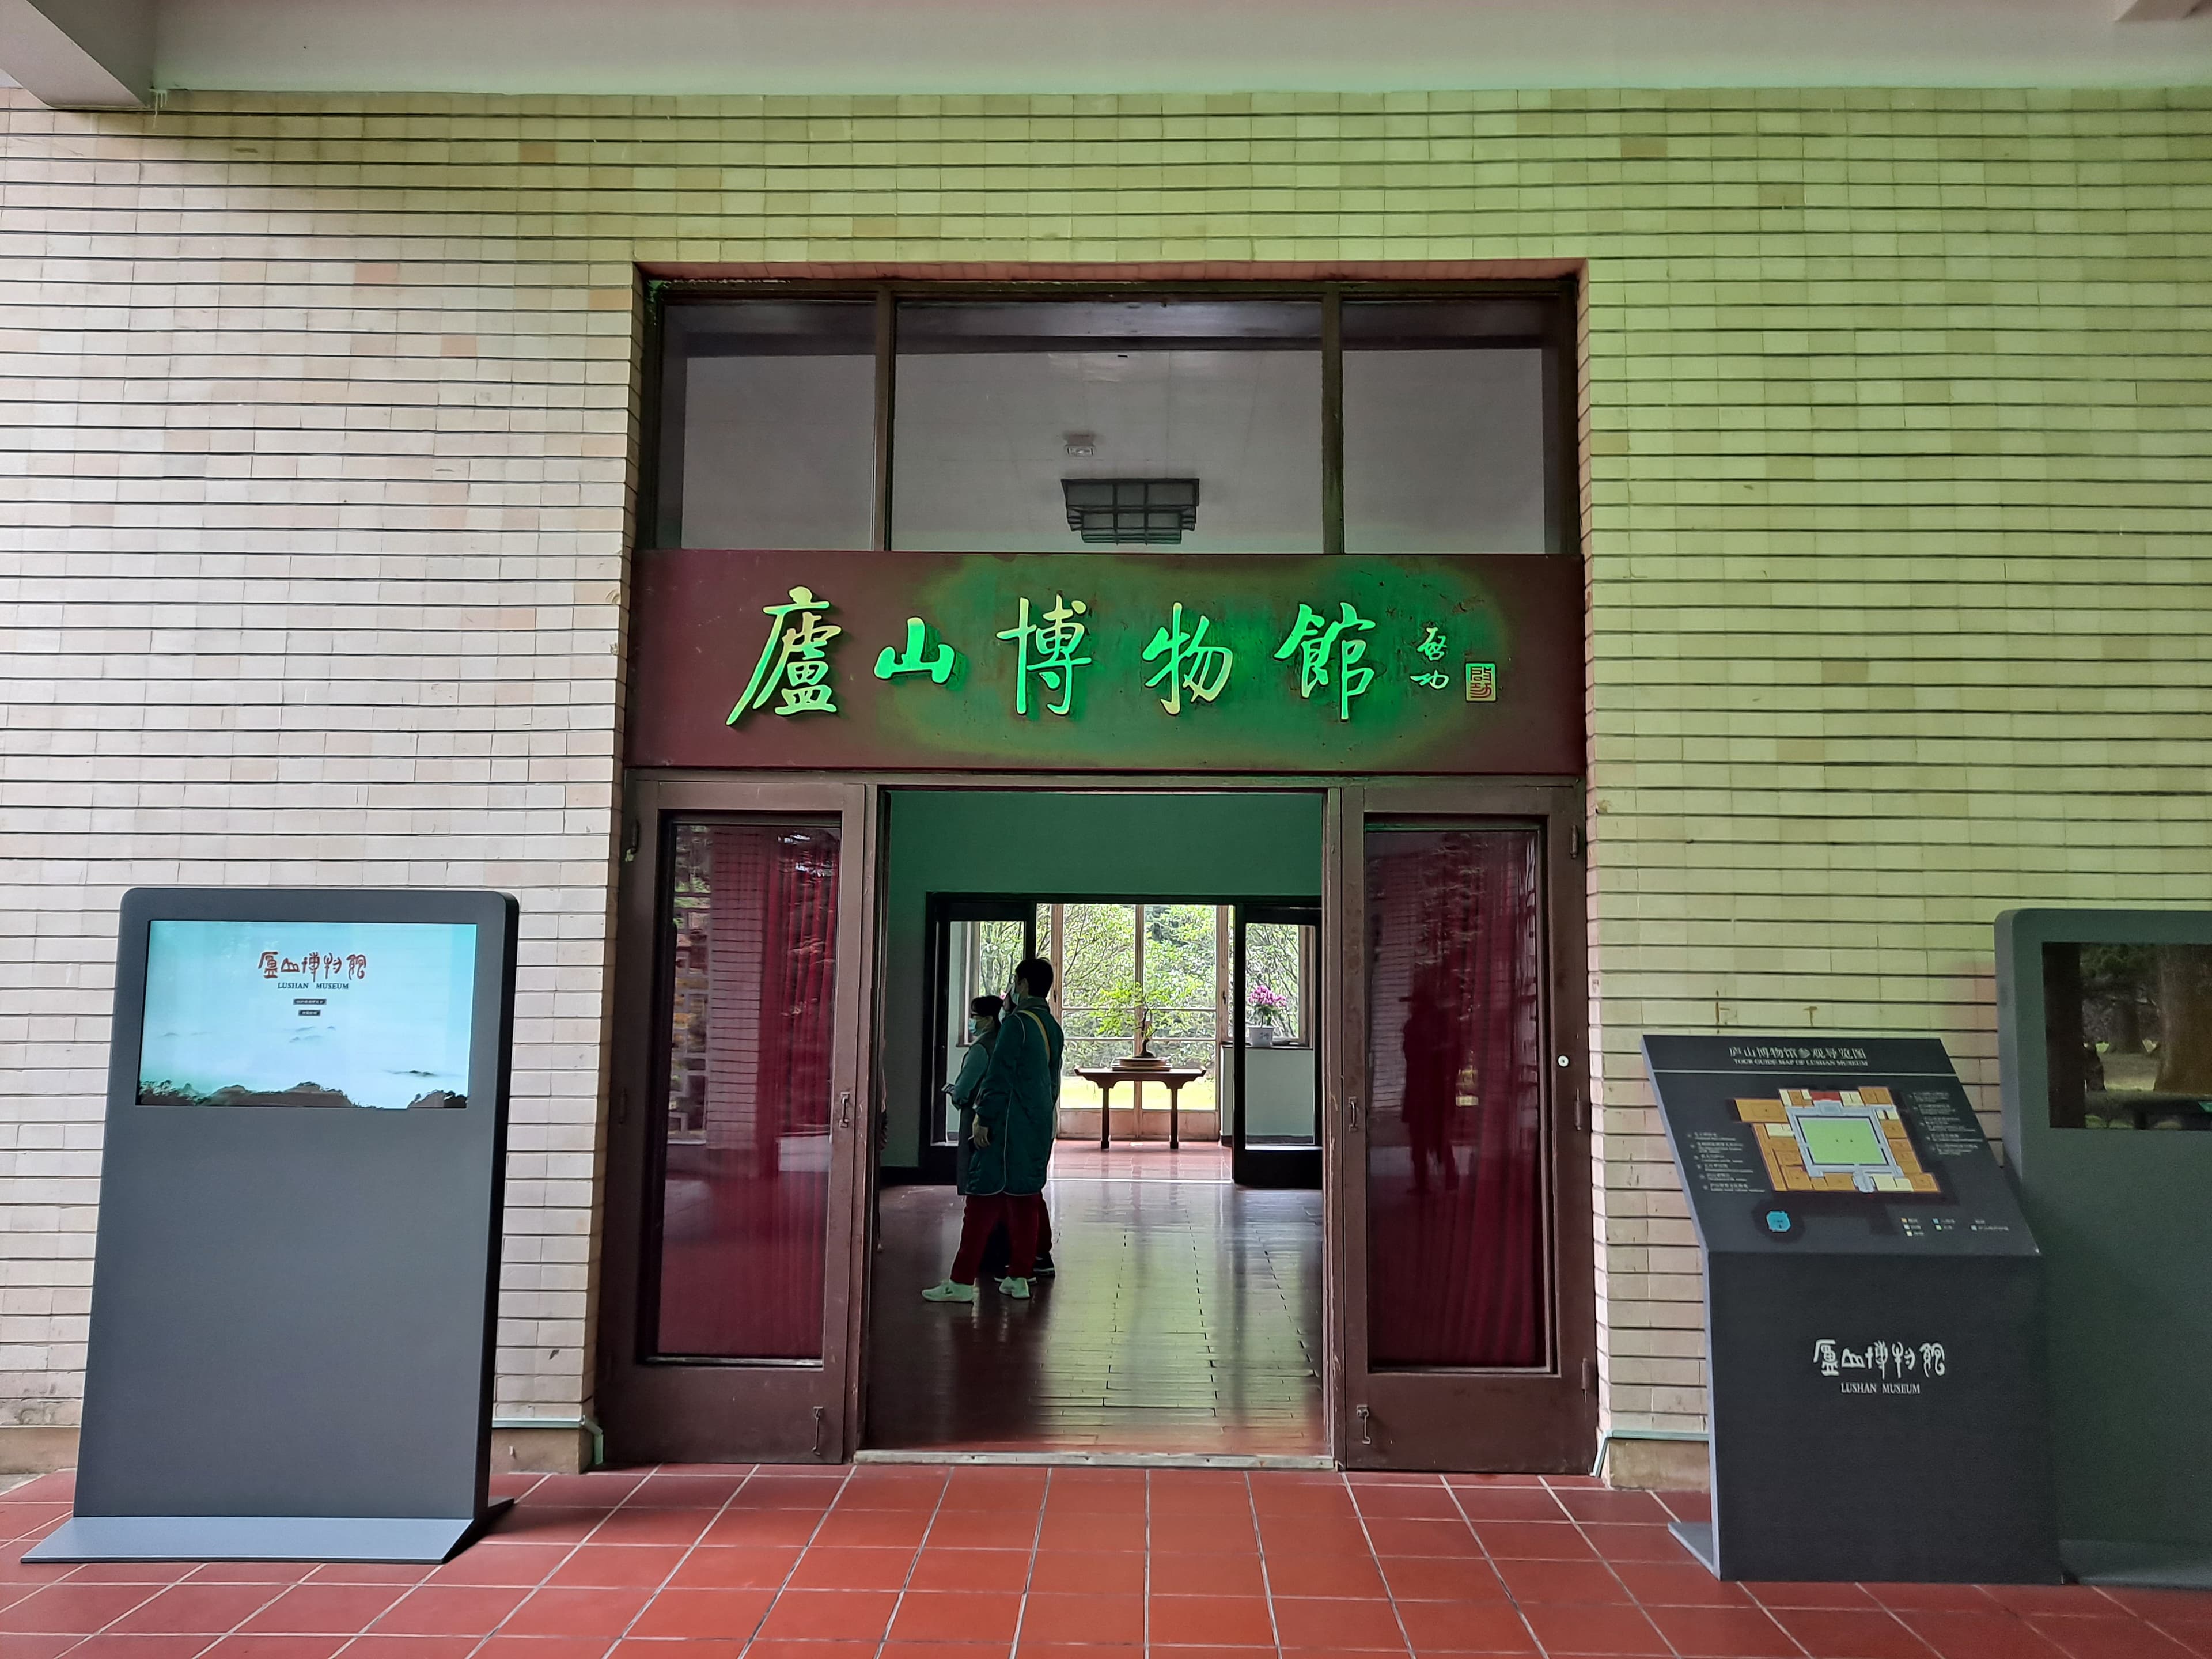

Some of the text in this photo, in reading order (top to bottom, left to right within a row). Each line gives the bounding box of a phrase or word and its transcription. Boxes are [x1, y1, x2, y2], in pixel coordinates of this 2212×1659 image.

[725, 586, 1377, 726] 廬山博物館
[1841, 1382, 1921, 1394] LUSHAN MUSEUM
